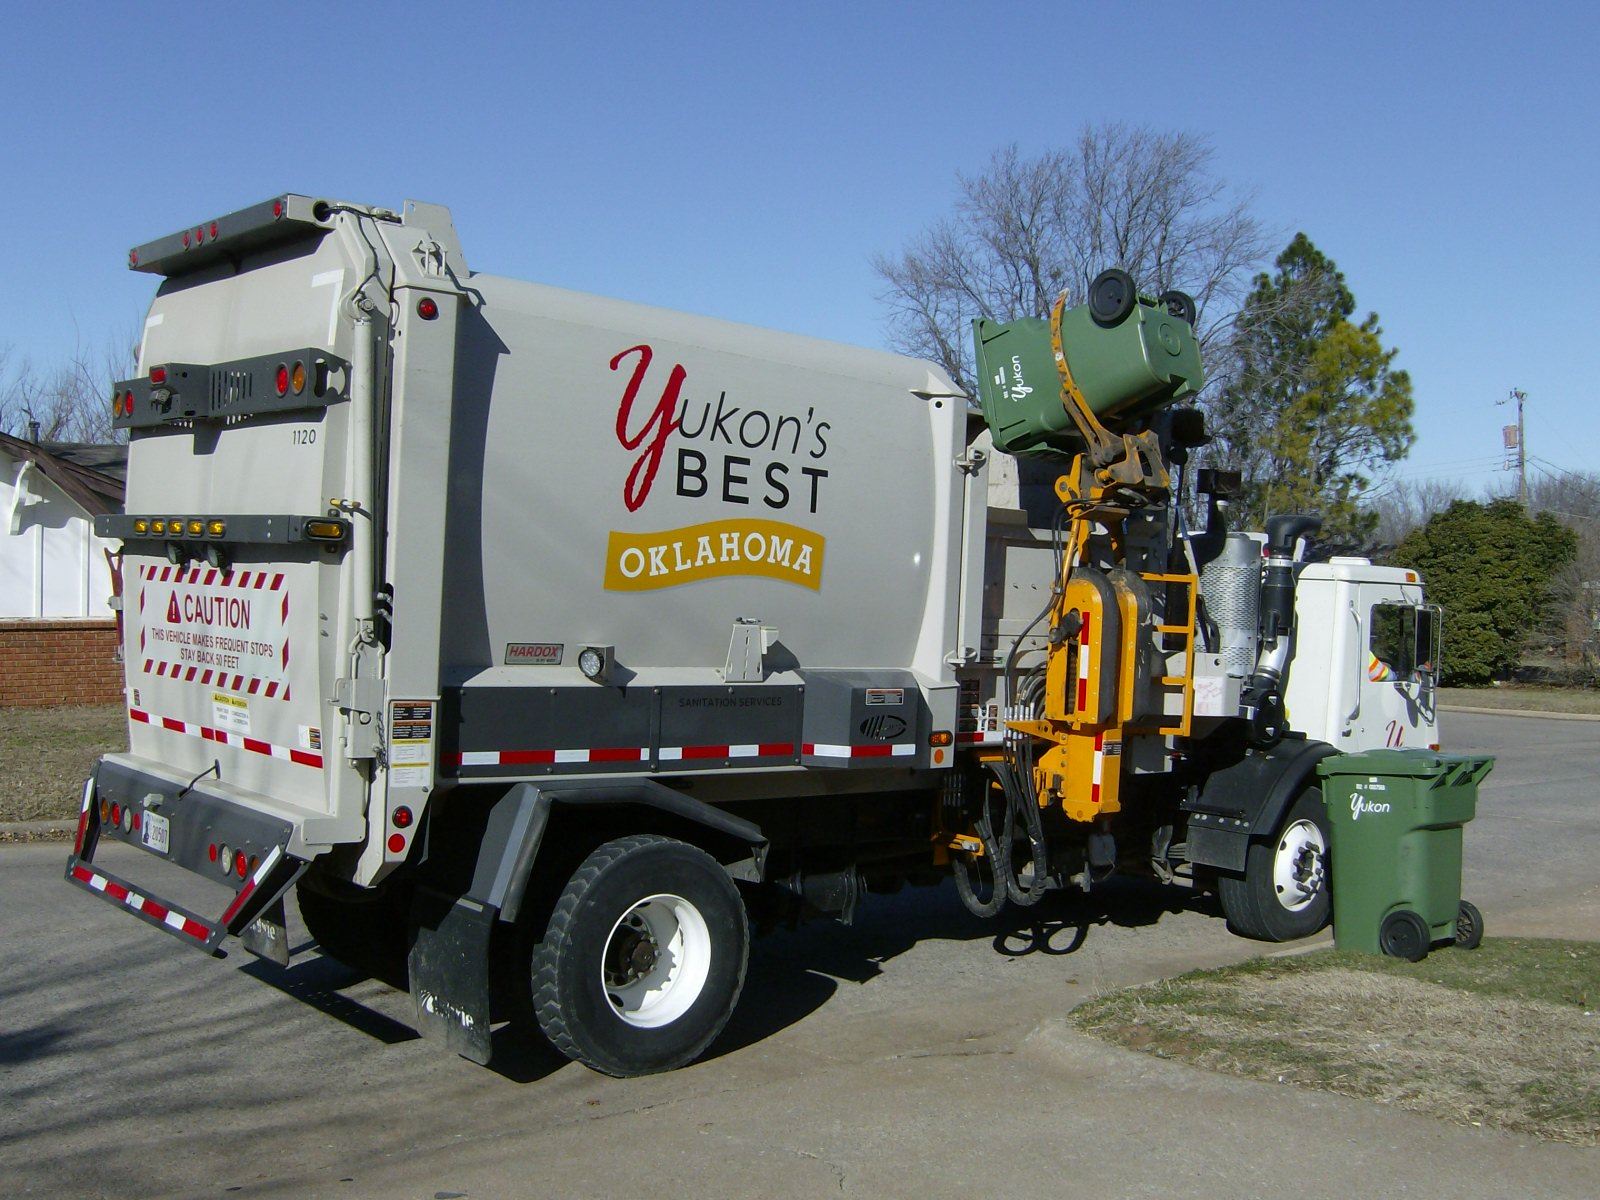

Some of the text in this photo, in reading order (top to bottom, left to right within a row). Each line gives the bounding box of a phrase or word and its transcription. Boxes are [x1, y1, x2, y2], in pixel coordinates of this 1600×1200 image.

[1011, 355, 1034, 402] Yukon
[293, 429, 316, 445] 1120
[609, 344, 831, 513] Yukon's
[676, 447, 829, 514] BEST
[619, 532, 813, 578] OKLAHOMA
[184, 594, 251, 630] CAUTION
[152, 628, 274, 658] THIS VEHICLE MAKES FREQUENT STOPS
[509, 645, 559, 658] HARDOX
[180, 648, 240, 669] STAY BACK 50 FEET
[679, 696, 783, 709] SANITATION SERVICES
[1349, 792, 1390, 821] Yukon
